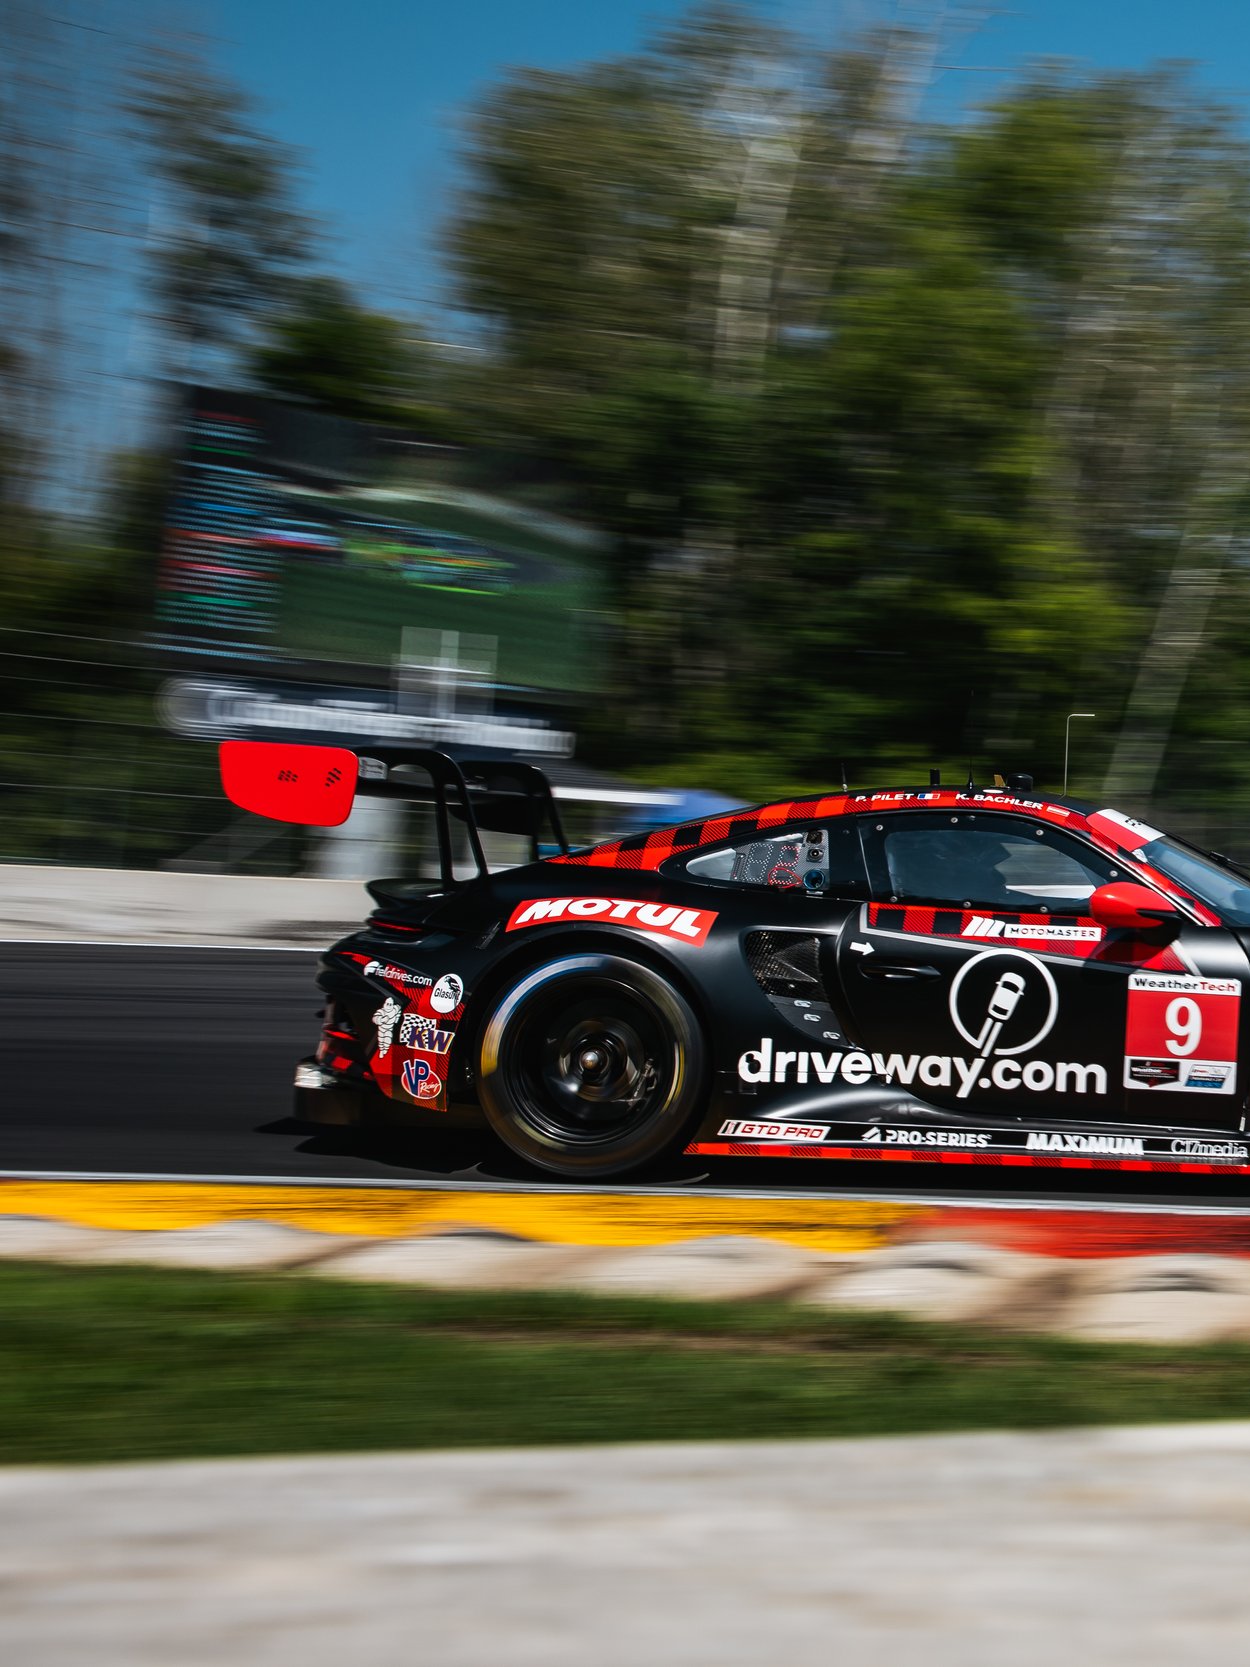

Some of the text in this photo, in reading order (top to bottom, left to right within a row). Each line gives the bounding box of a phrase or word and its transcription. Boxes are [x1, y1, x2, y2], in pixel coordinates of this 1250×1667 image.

[871, 793, 914, 801] PILET
[955, 793, 1043, 810] K. BACHLER
[515, 899, 702, 937] MOTUL
[1010, 927, 1096, 938] MOTOMASTER
[1134, 978, 1236, 992] WeatherTech
[1165, 997, 1202, 1056] 9
[409, 1025, 454, 1053] KW
[403, 1059, 430, 1096] VP
[738, 1038, 1107, 1098] driveway.com
[741, 1124, 823, 1138] GTD PRO
